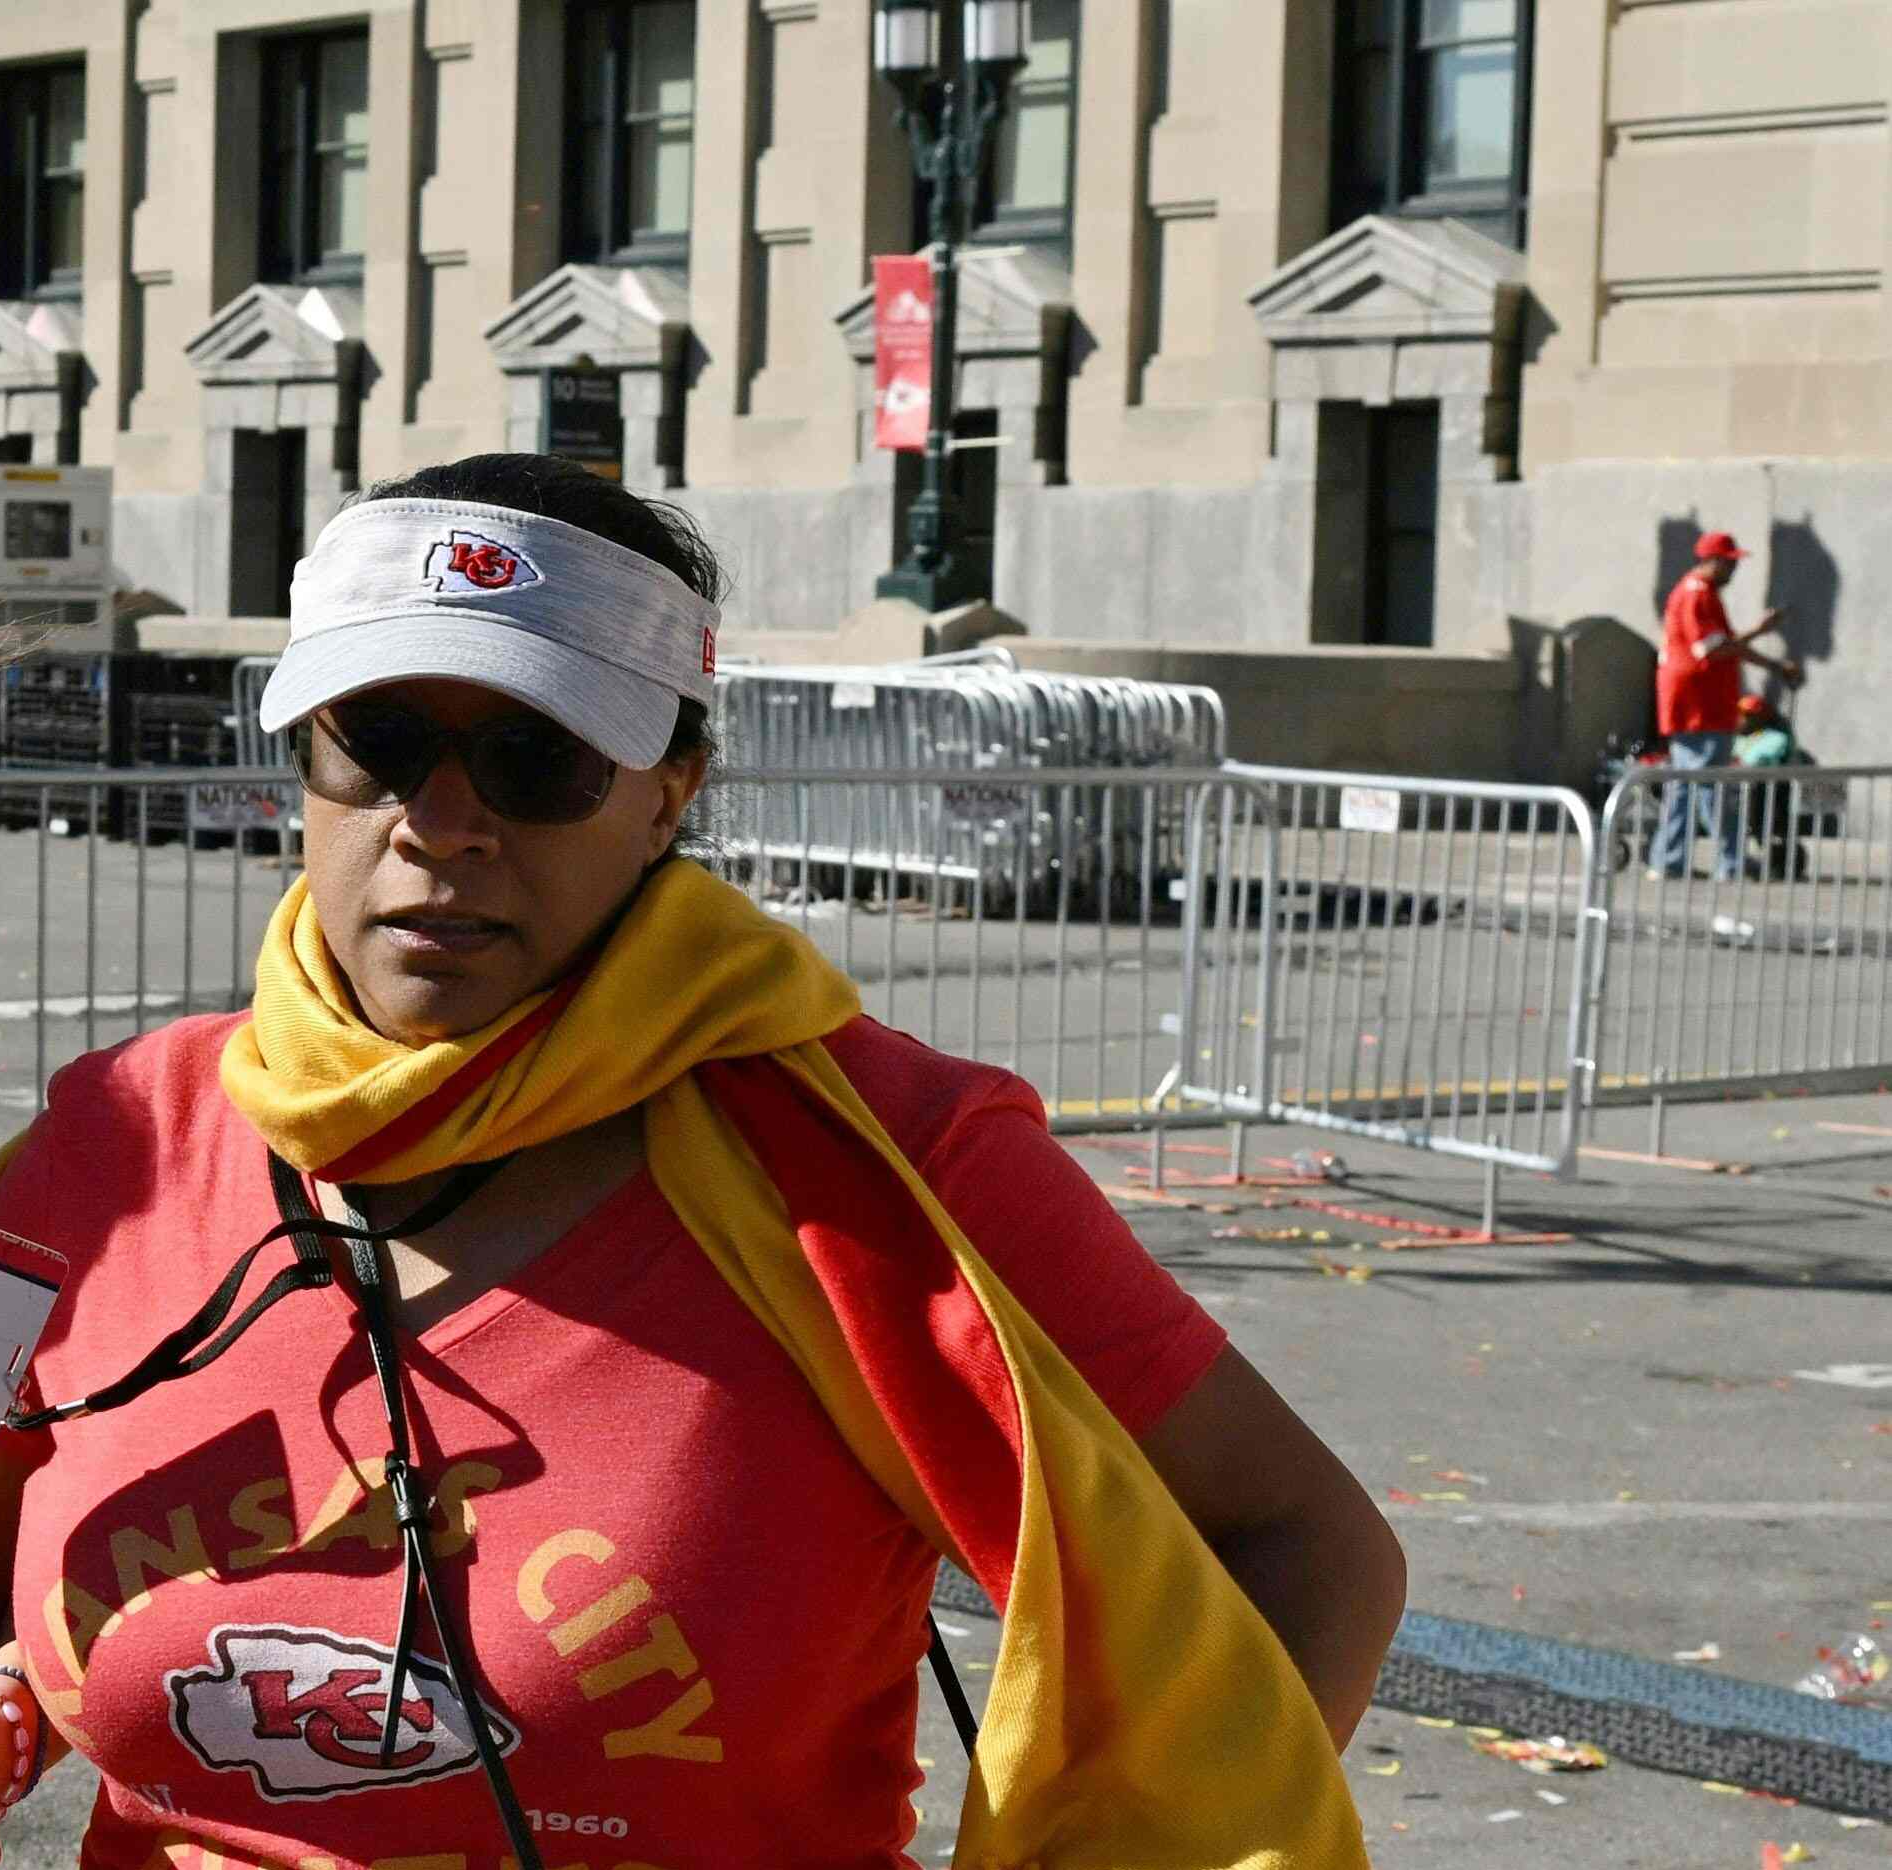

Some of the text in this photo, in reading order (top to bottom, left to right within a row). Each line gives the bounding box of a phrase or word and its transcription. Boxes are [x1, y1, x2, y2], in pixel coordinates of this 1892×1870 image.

[448, 543, 517, 587] KC
[515, 1528, 725, 1764] CITY
[240, 1669, 436, 1769] KC
[523, 1808, 629, 1840] 1960
